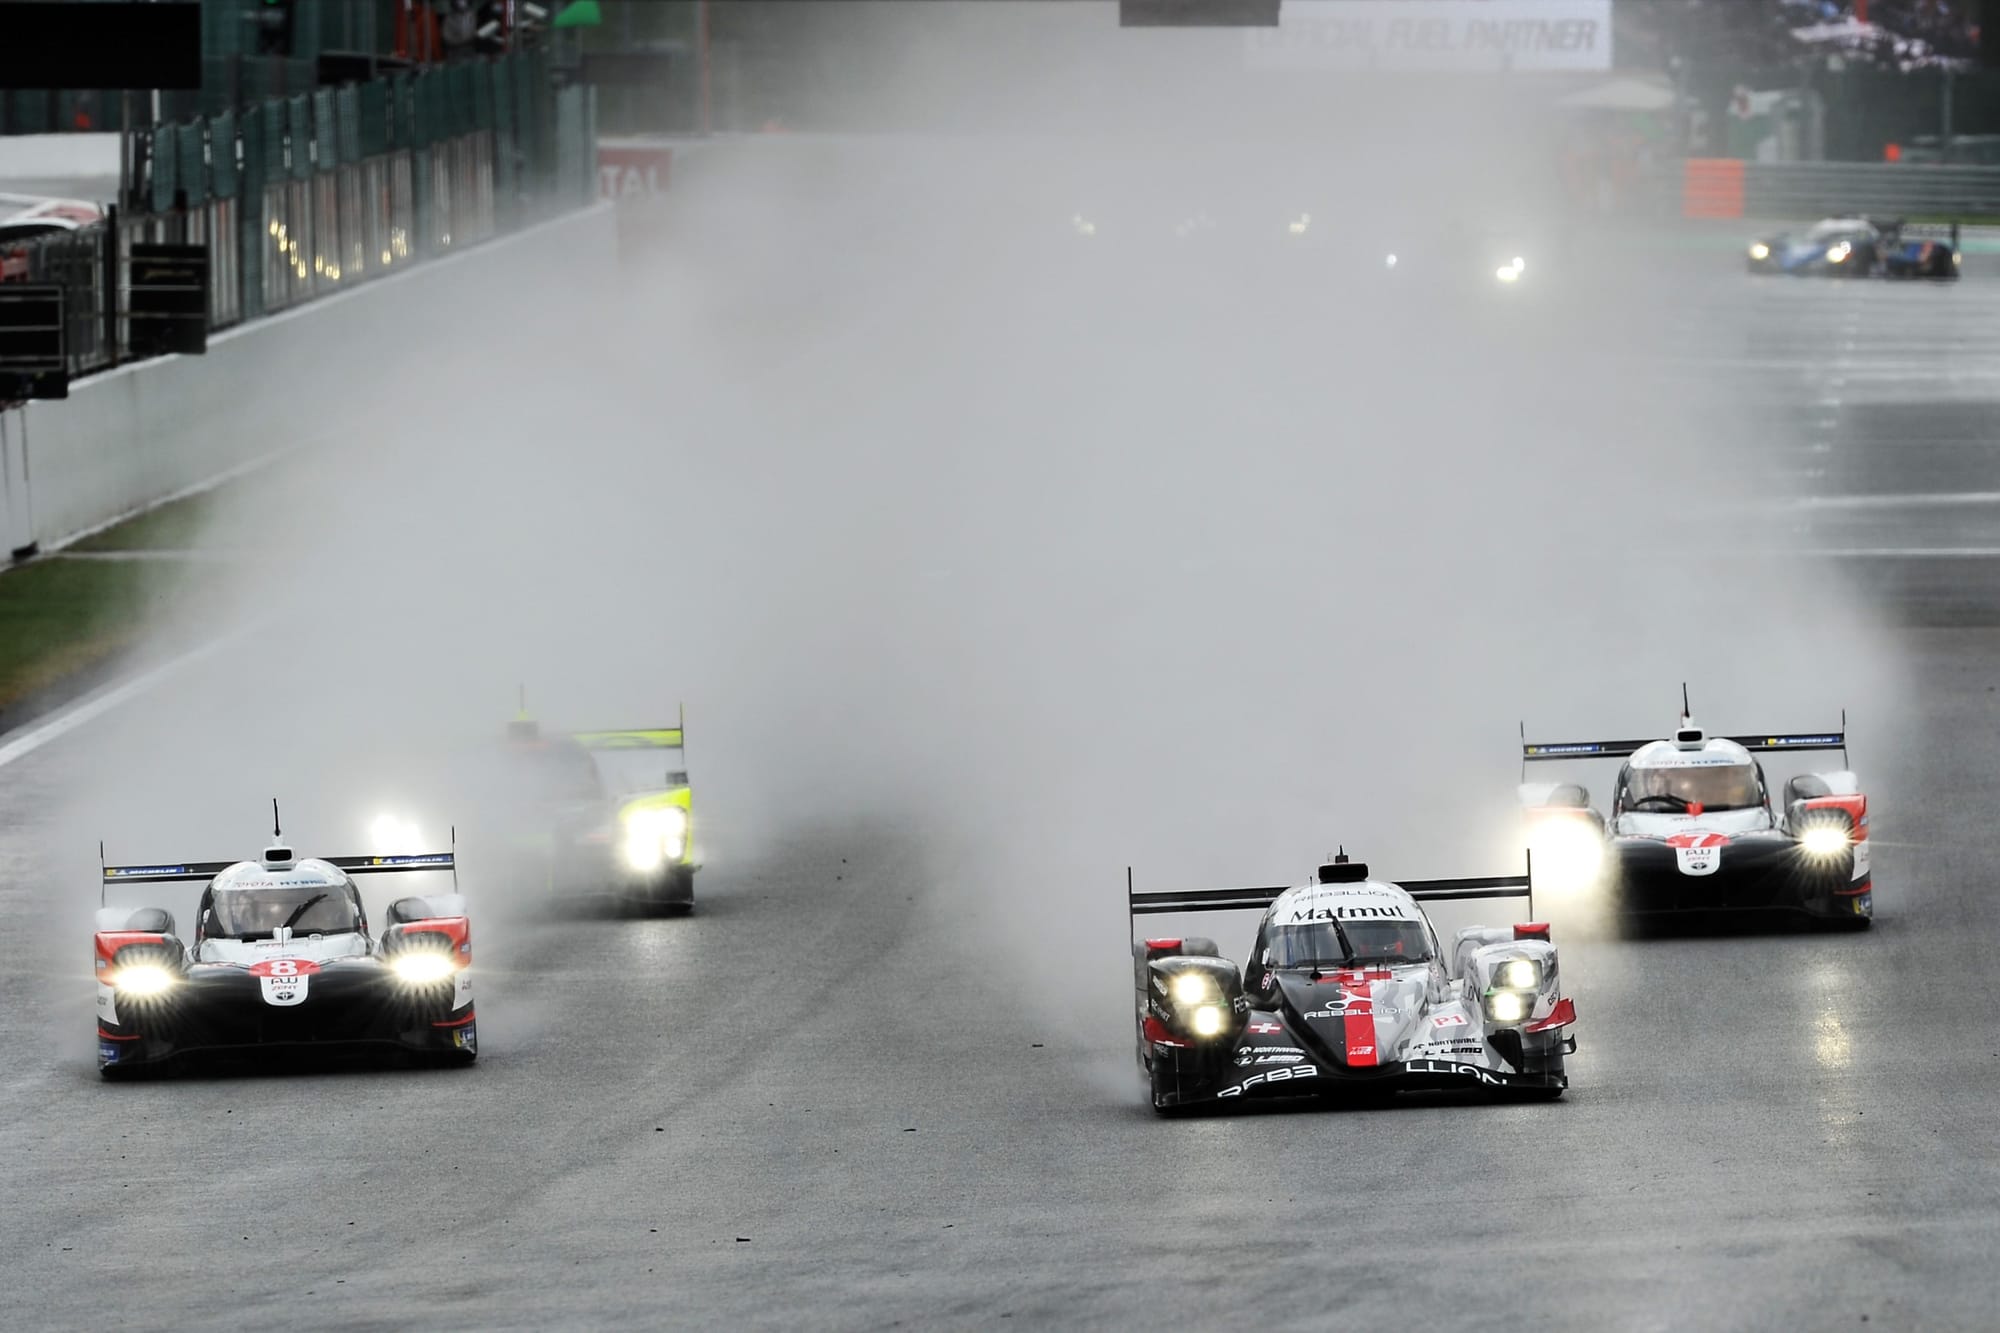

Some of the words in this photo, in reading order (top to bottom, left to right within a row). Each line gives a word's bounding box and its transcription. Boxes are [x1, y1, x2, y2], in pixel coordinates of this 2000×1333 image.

[1385, 18, 1457, 50] FUEL
[1463, 18, 1598, 51] PARTNER
[1685, 833, 1714, 848] 7
[1290, 905, 1405, 923] Matmut
[269, 959, 299, 977] 8
[1434, 1015, 1464, 1026] P1
[1440, 1047, 1483, 1055] LEMO
